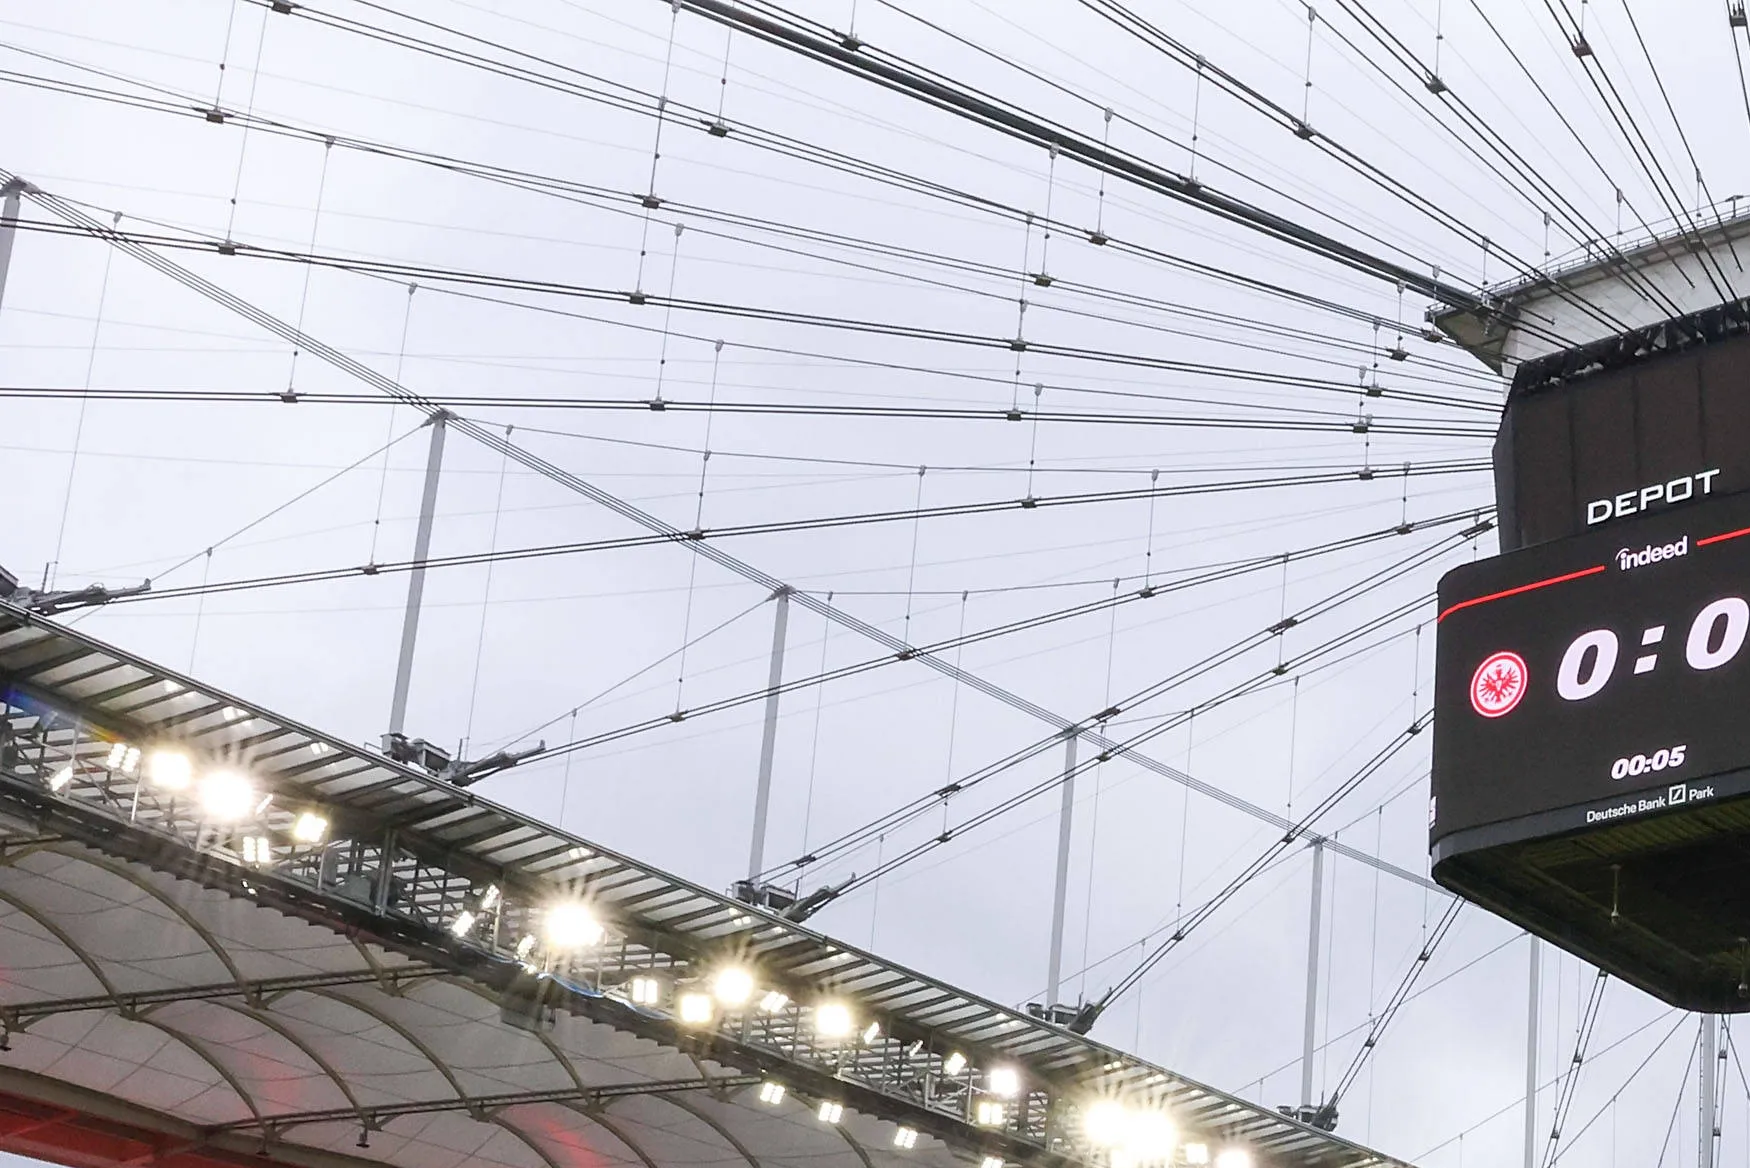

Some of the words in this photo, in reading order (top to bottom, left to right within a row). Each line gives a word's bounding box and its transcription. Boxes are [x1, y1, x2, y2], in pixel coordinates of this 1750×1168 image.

[1587, 469, 1720, 525] DEPOT
[1615, 535, 1688, 570] indeed
[1611, 745, 1686, 780] 00:05
[1587, 803, 1637, 822] Deutsche
[1639, 797, 1666, 812] Bank
[1689, 786, 1714, 801] Park
